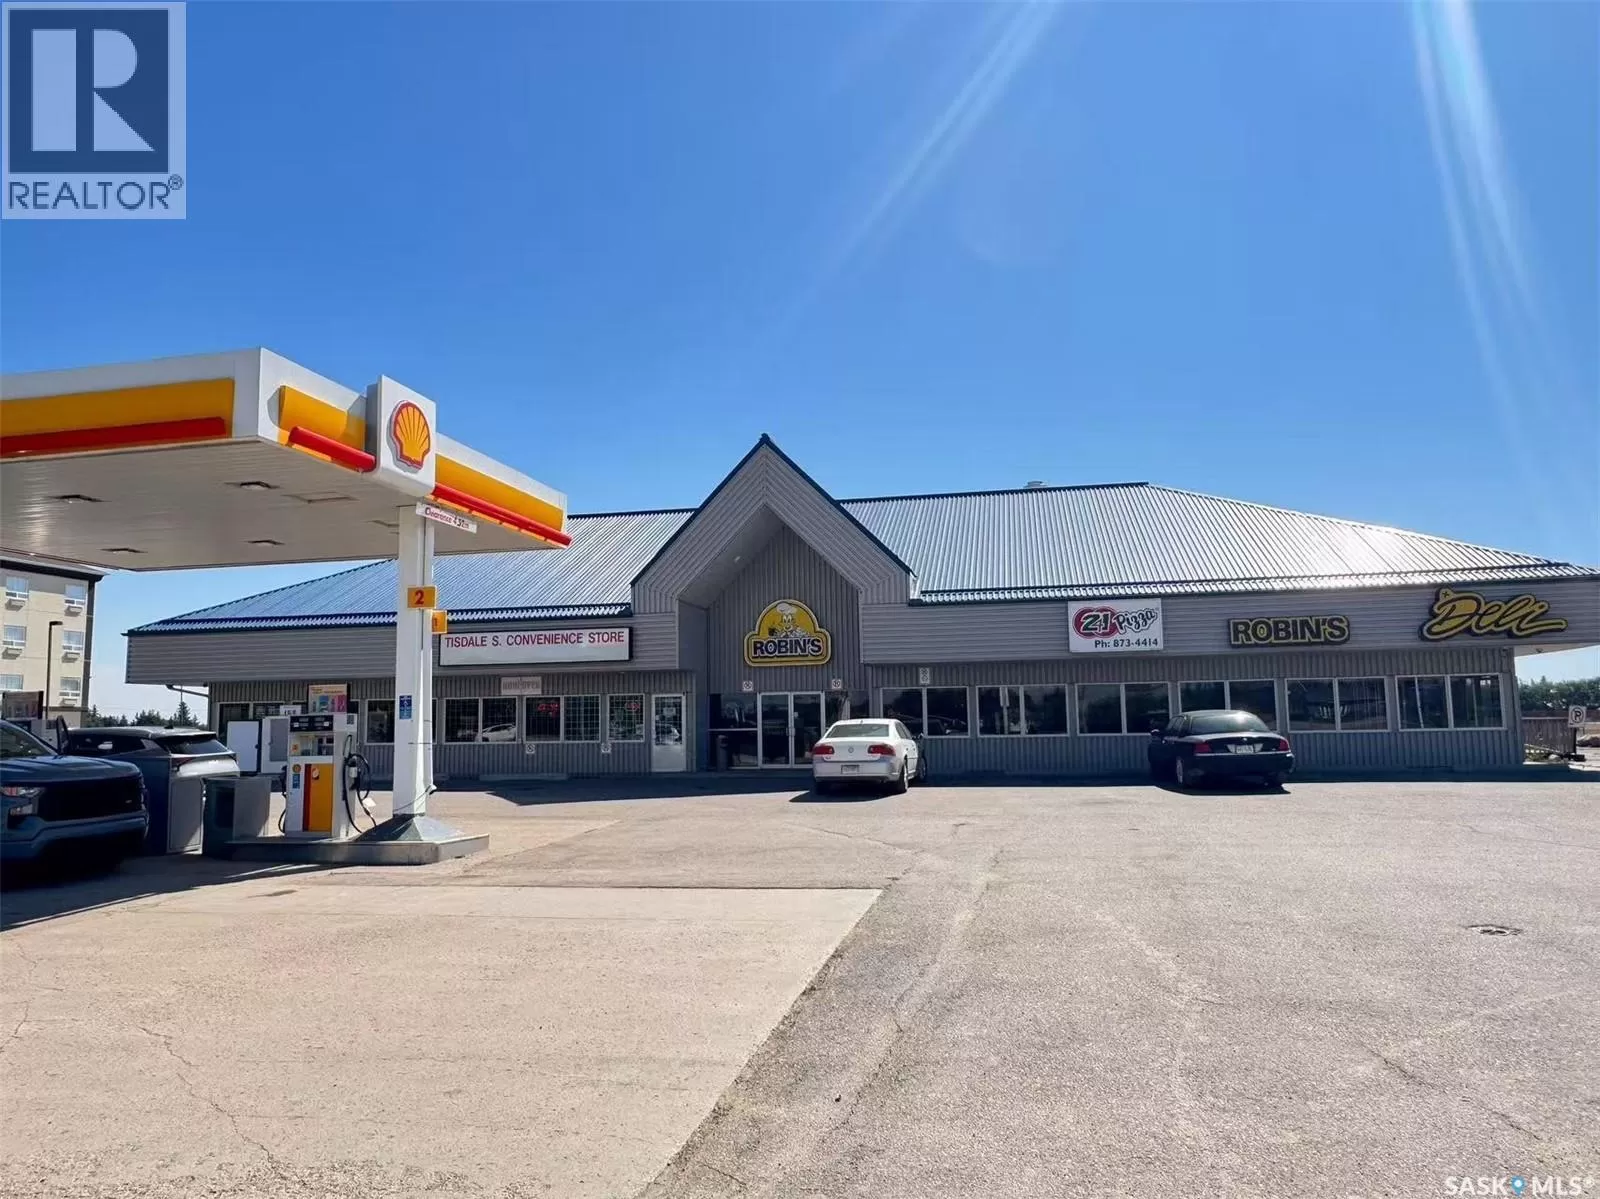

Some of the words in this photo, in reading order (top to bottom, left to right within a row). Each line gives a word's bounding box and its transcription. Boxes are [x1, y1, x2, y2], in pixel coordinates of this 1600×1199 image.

[414, 589, 425, 605] 2
[1112, 608, 1157, 634] Pizza
[1423, 588, 1568, 640] Deli
[445, 635, 488, 648] TISDALE
[491, 635, 502, 647] S.
[506, 632, 584, 646] CONVENIENCE
[588, 631, 625, 643] STORE
[1230, 616, 1349, 644] ROBIN'S
[752, 637, 823, 657] ROBIN'S
[1094, 639, 1111, 649] Ph:
[1113, 638, 1159, 648] 873-4414
